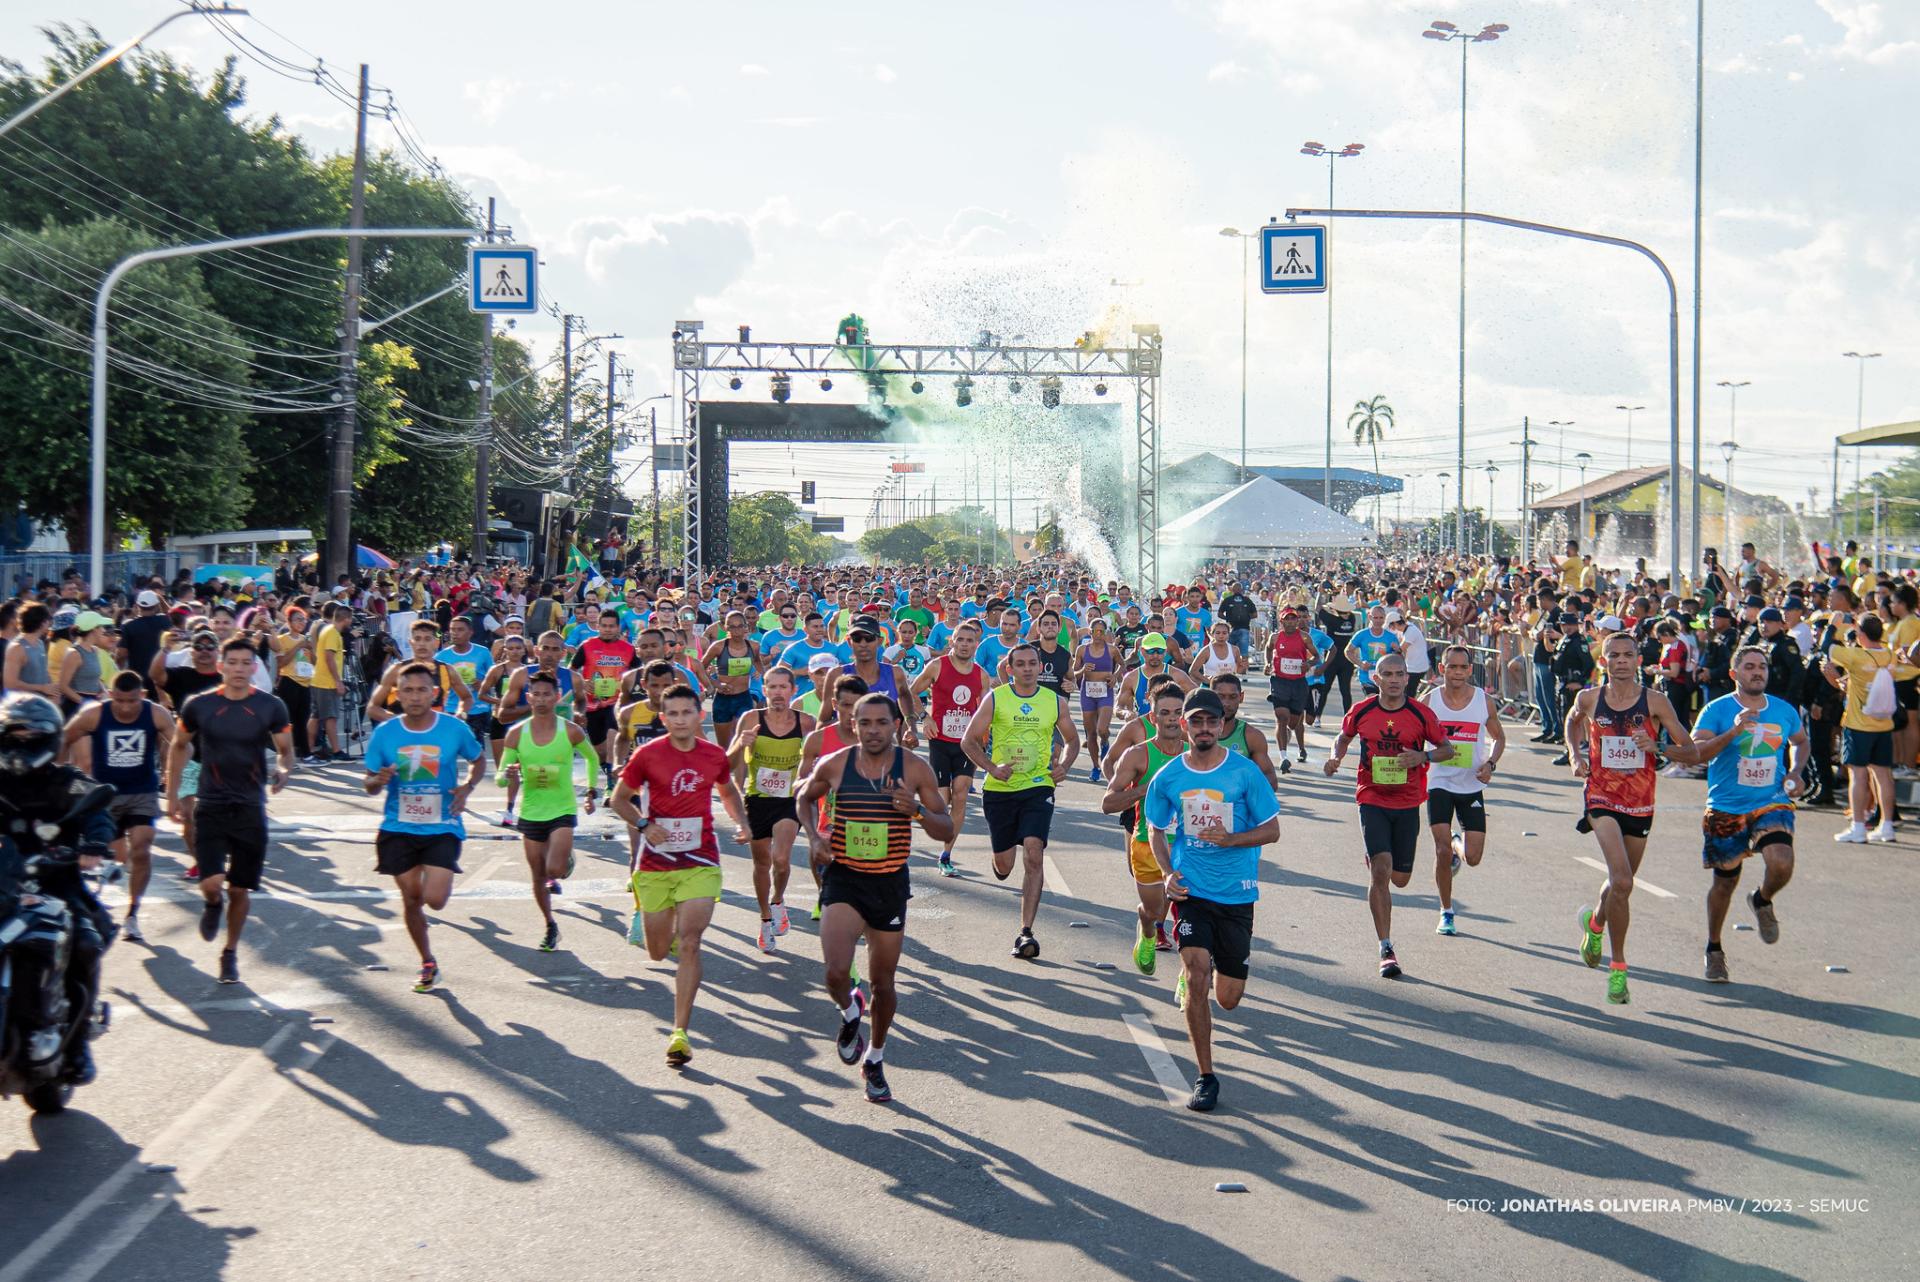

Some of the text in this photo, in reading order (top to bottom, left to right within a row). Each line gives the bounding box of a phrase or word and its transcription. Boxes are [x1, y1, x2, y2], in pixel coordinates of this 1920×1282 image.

[1377, 740, 1402, 751] EPIC
[1608, 748, 1637, 760] 3494
[1745, 768, 1771, 779] 3497
[761, 778, 787, 789] 2093
[405, 804, 433, 816] 2904
[1191, 814, 1223, 827] 2476
[667, 831, 693, 843] 582
[852, 836, 879, 847] 0143
